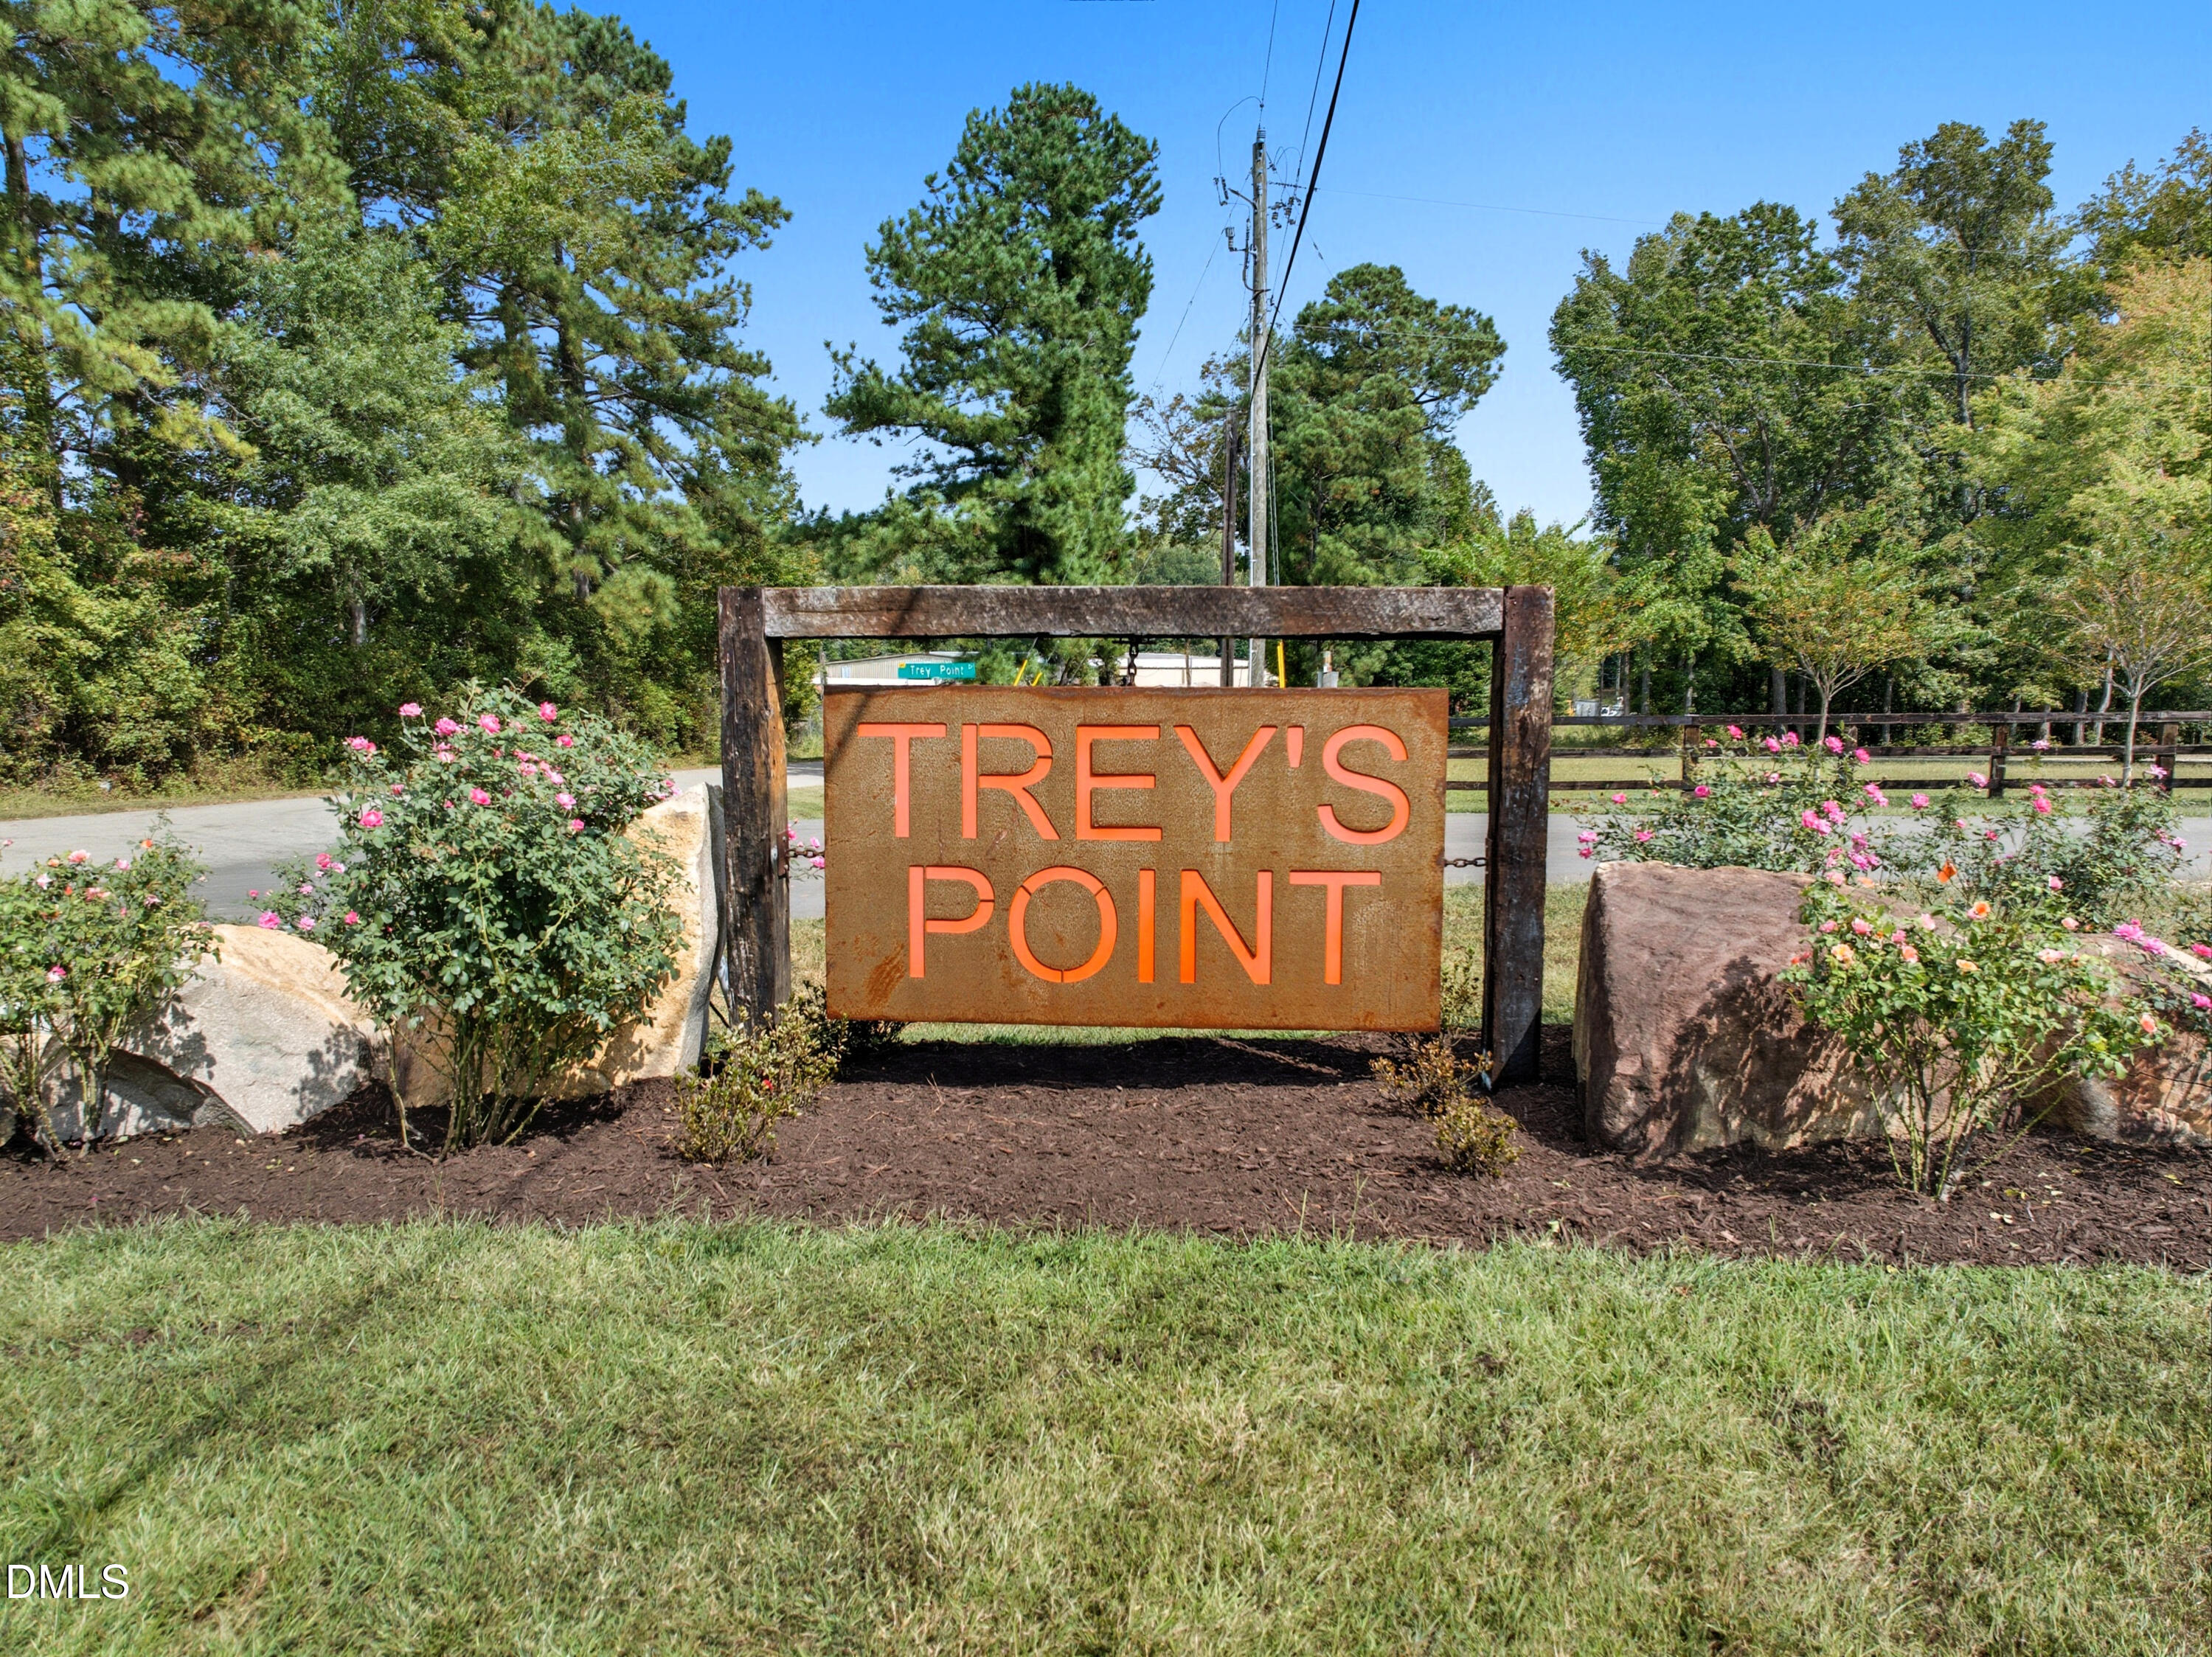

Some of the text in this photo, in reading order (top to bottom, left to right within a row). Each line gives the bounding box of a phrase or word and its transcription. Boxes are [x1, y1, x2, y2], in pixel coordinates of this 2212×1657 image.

[910, 665, 931, 678] Trey
[940, 665, 964, 675] Point
[857, 723, 1411, 845] TREY'S
[909, 866, 1381, 984] POINT
